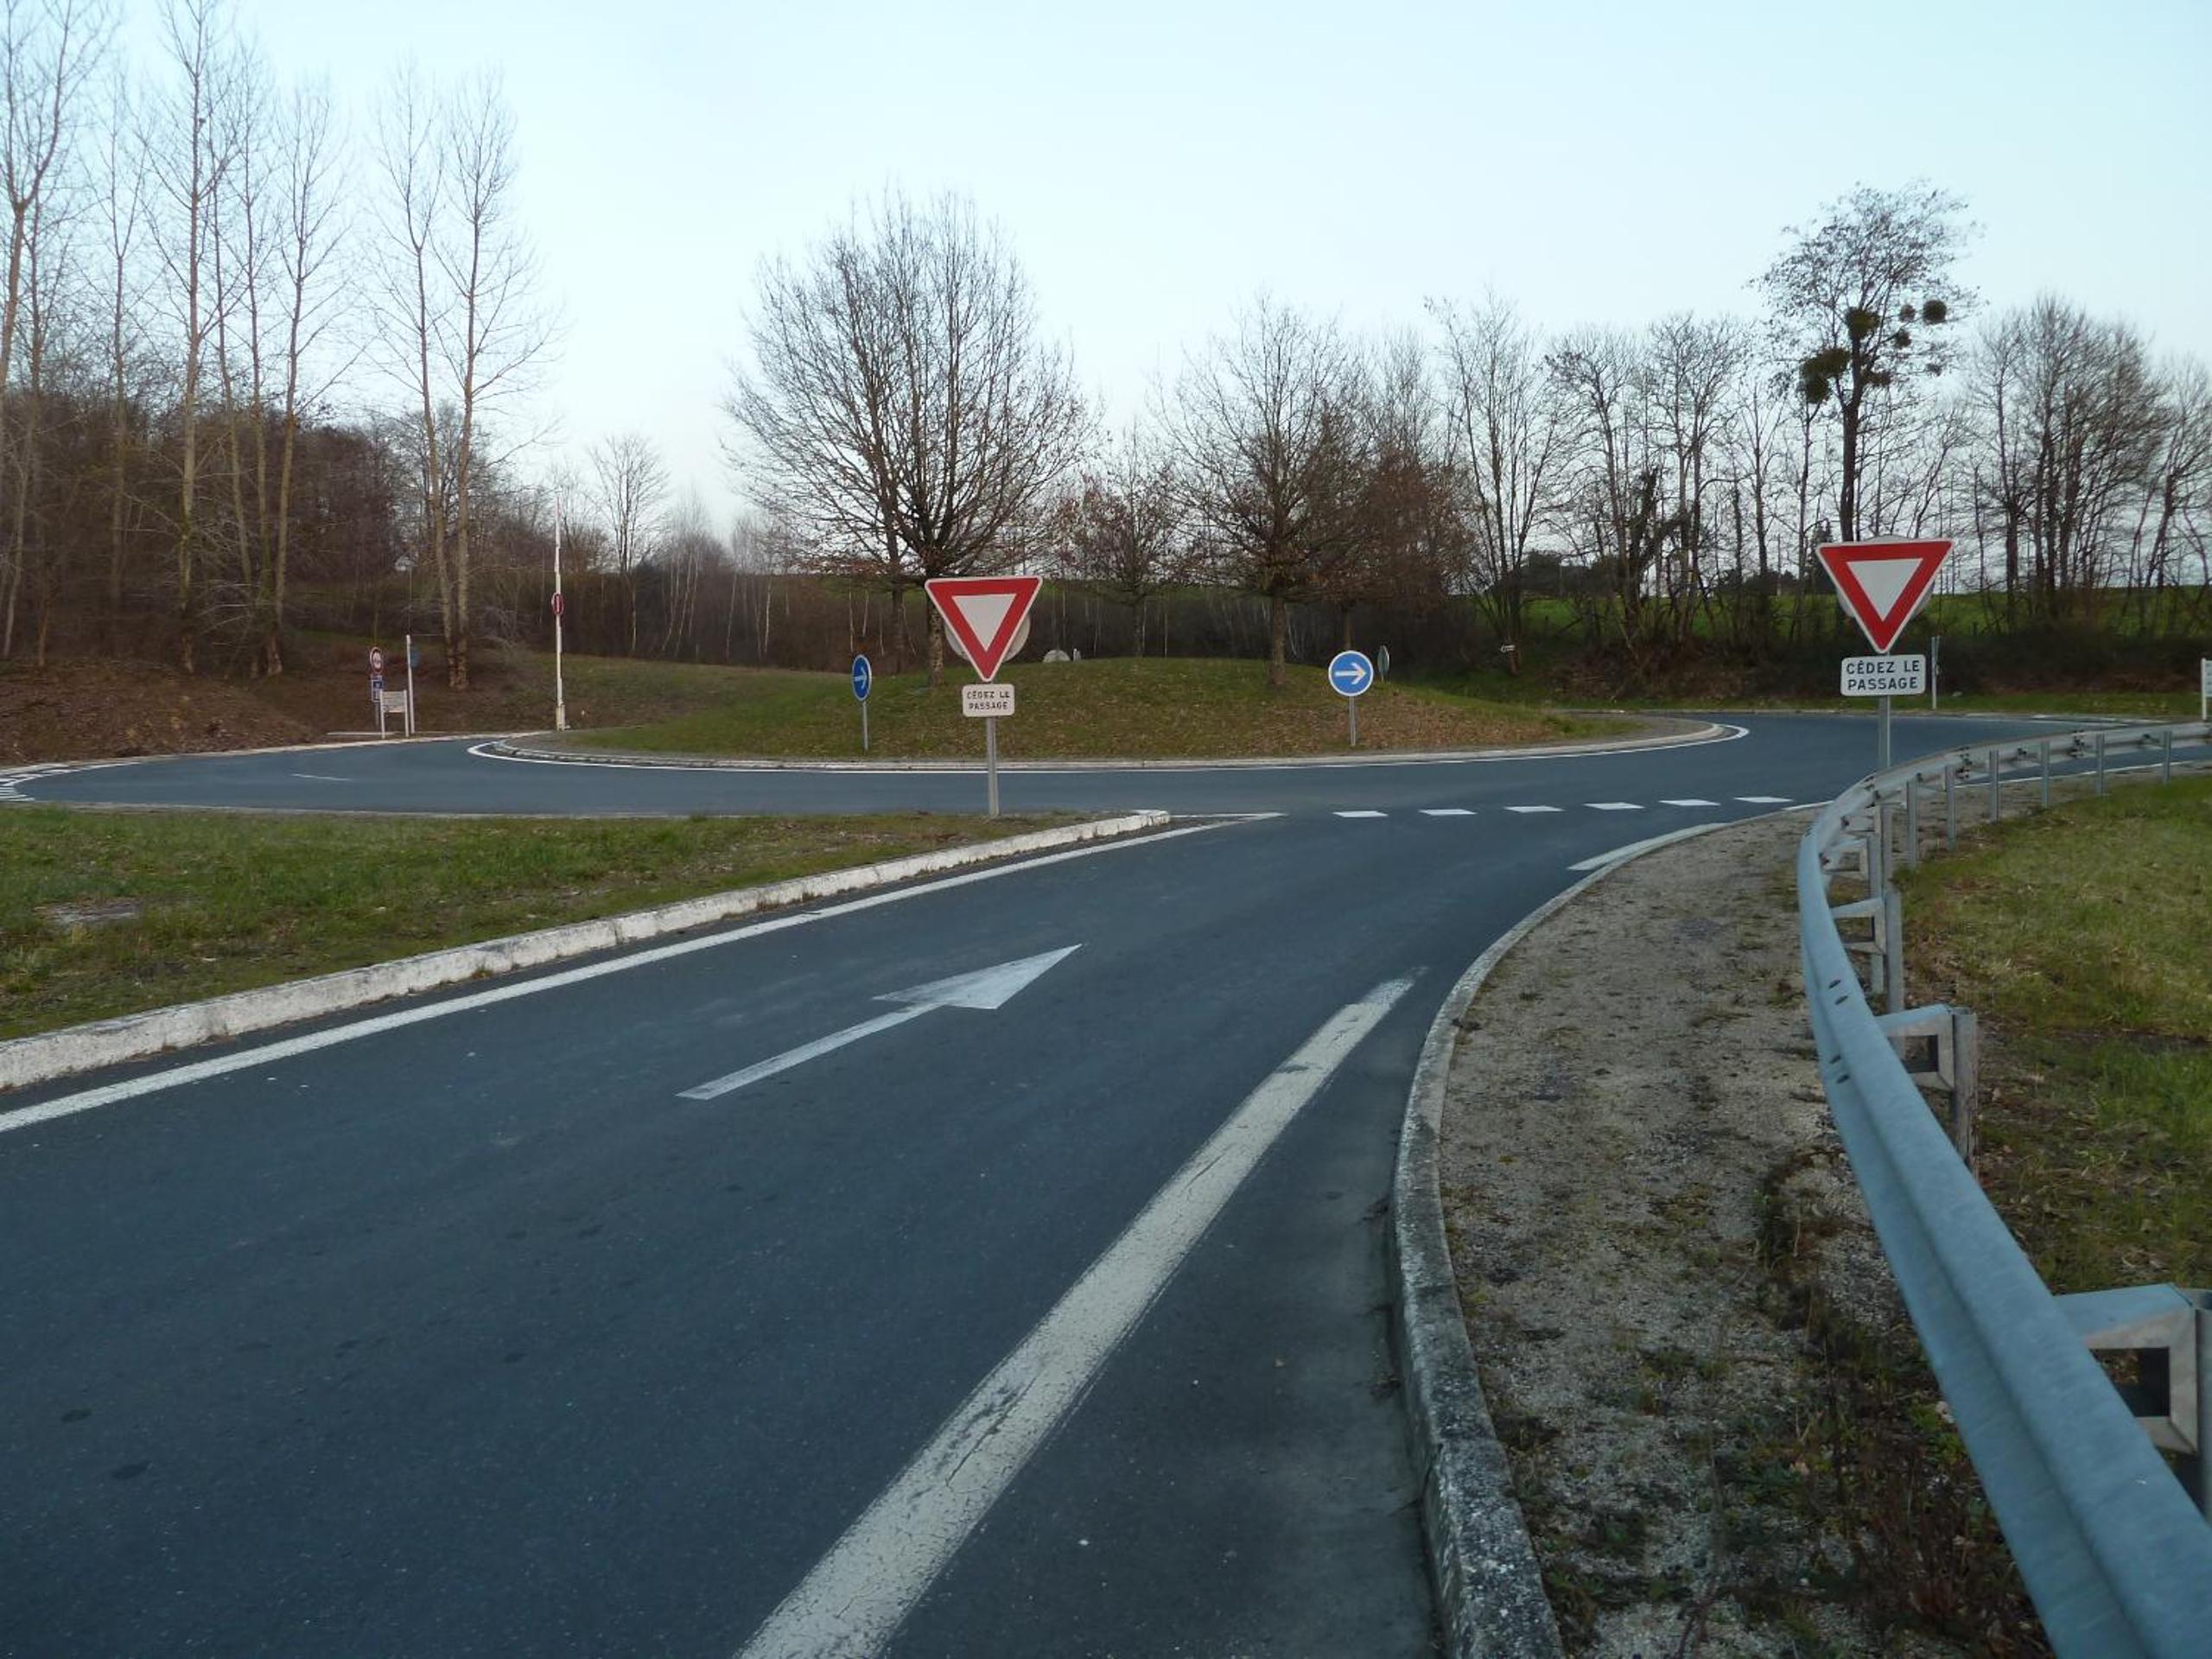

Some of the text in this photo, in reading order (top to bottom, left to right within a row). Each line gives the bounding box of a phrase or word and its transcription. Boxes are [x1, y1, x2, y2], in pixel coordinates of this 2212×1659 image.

[1847, 660, 1920, 674] CÉDEZ LE
[1847, 677, 1918, 690] PASSAGE
